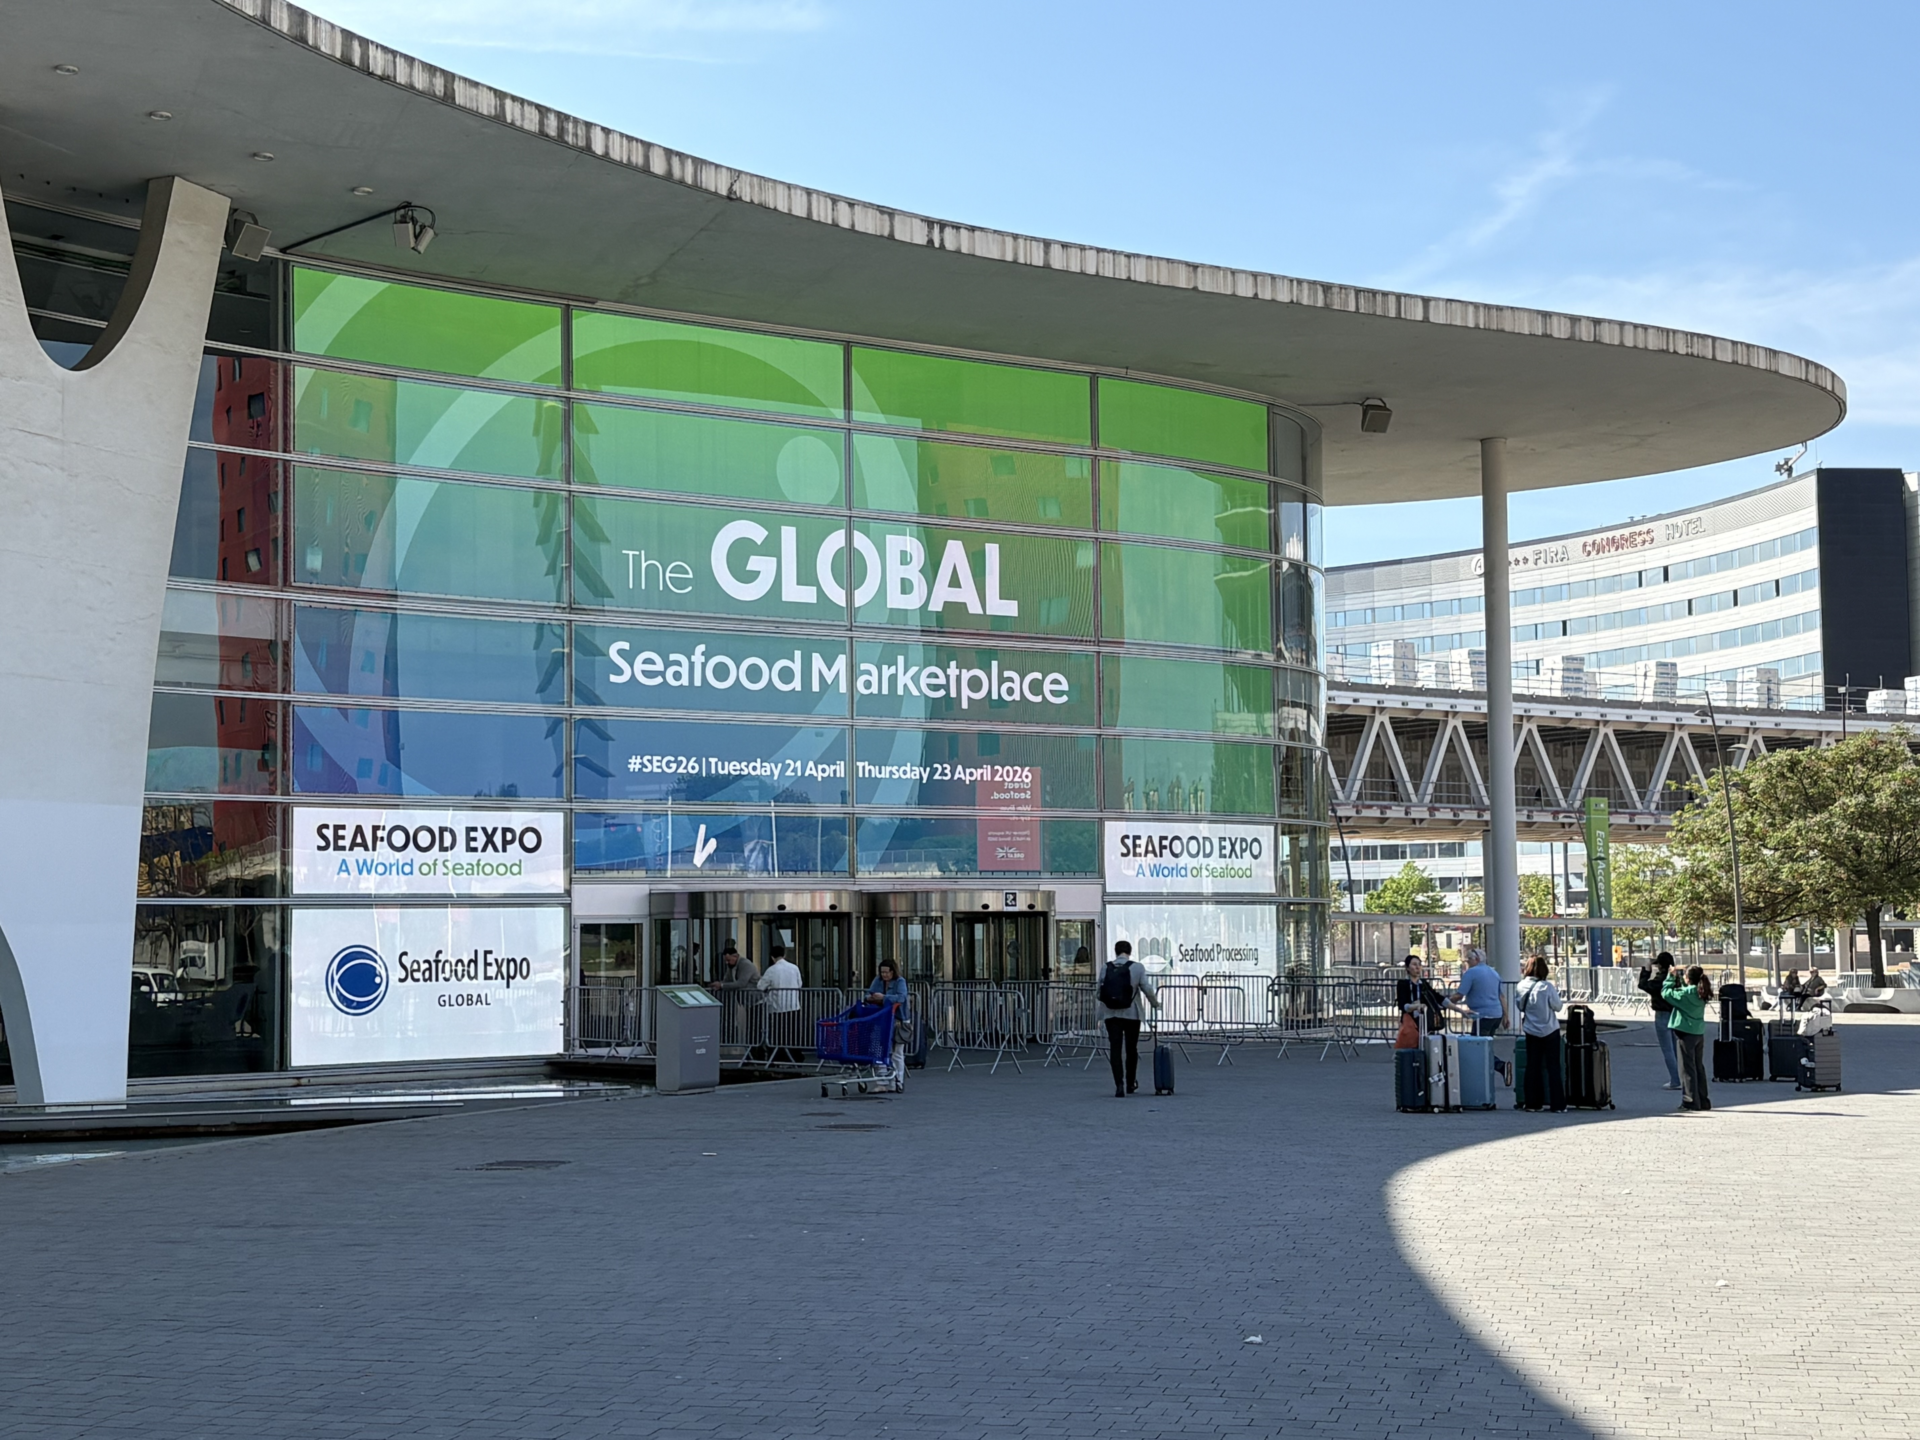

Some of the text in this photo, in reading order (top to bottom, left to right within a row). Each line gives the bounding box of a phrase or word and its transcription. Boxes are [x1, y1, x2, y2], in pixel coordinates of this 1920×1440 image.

[1532, 545, 1570, 566] FIRA
[1581, 528, 1655, 557] CONGRESS
[1665, 516, 1706, 541] HOTEL
[622, 520, 1018, 617] The GLOBAL
[608, 641, 1070, 709] Seafood Marketplace
[627, 755, 699, 774] #SEG26
[709, 758, 782, 779] Tuesday
[784, 759, 803, 777] 21
[804, 759, 845, 781] April
[857, 761, 931, 783] Thursday
[932, 764, 952, 780] 23
[953, 764, 992, 784] April
[993, 765, 1032, 783] 2026
[316, 823, 542, 853] SEAFOOD EXPO
[1120, 834, 1262, 860] SEAFOOD EXPO
[1596, 830, 1606, 857] East
[337, 858, 522, 876] A World of Seafood
[1136, 863, 1252, 878] A World of Seafood
[397, 949, 531, 988] Seafood Expo
[1178, 943, 1259, 966] Seafood Processing
[438, 993, 492, 1007] GLOBAL
